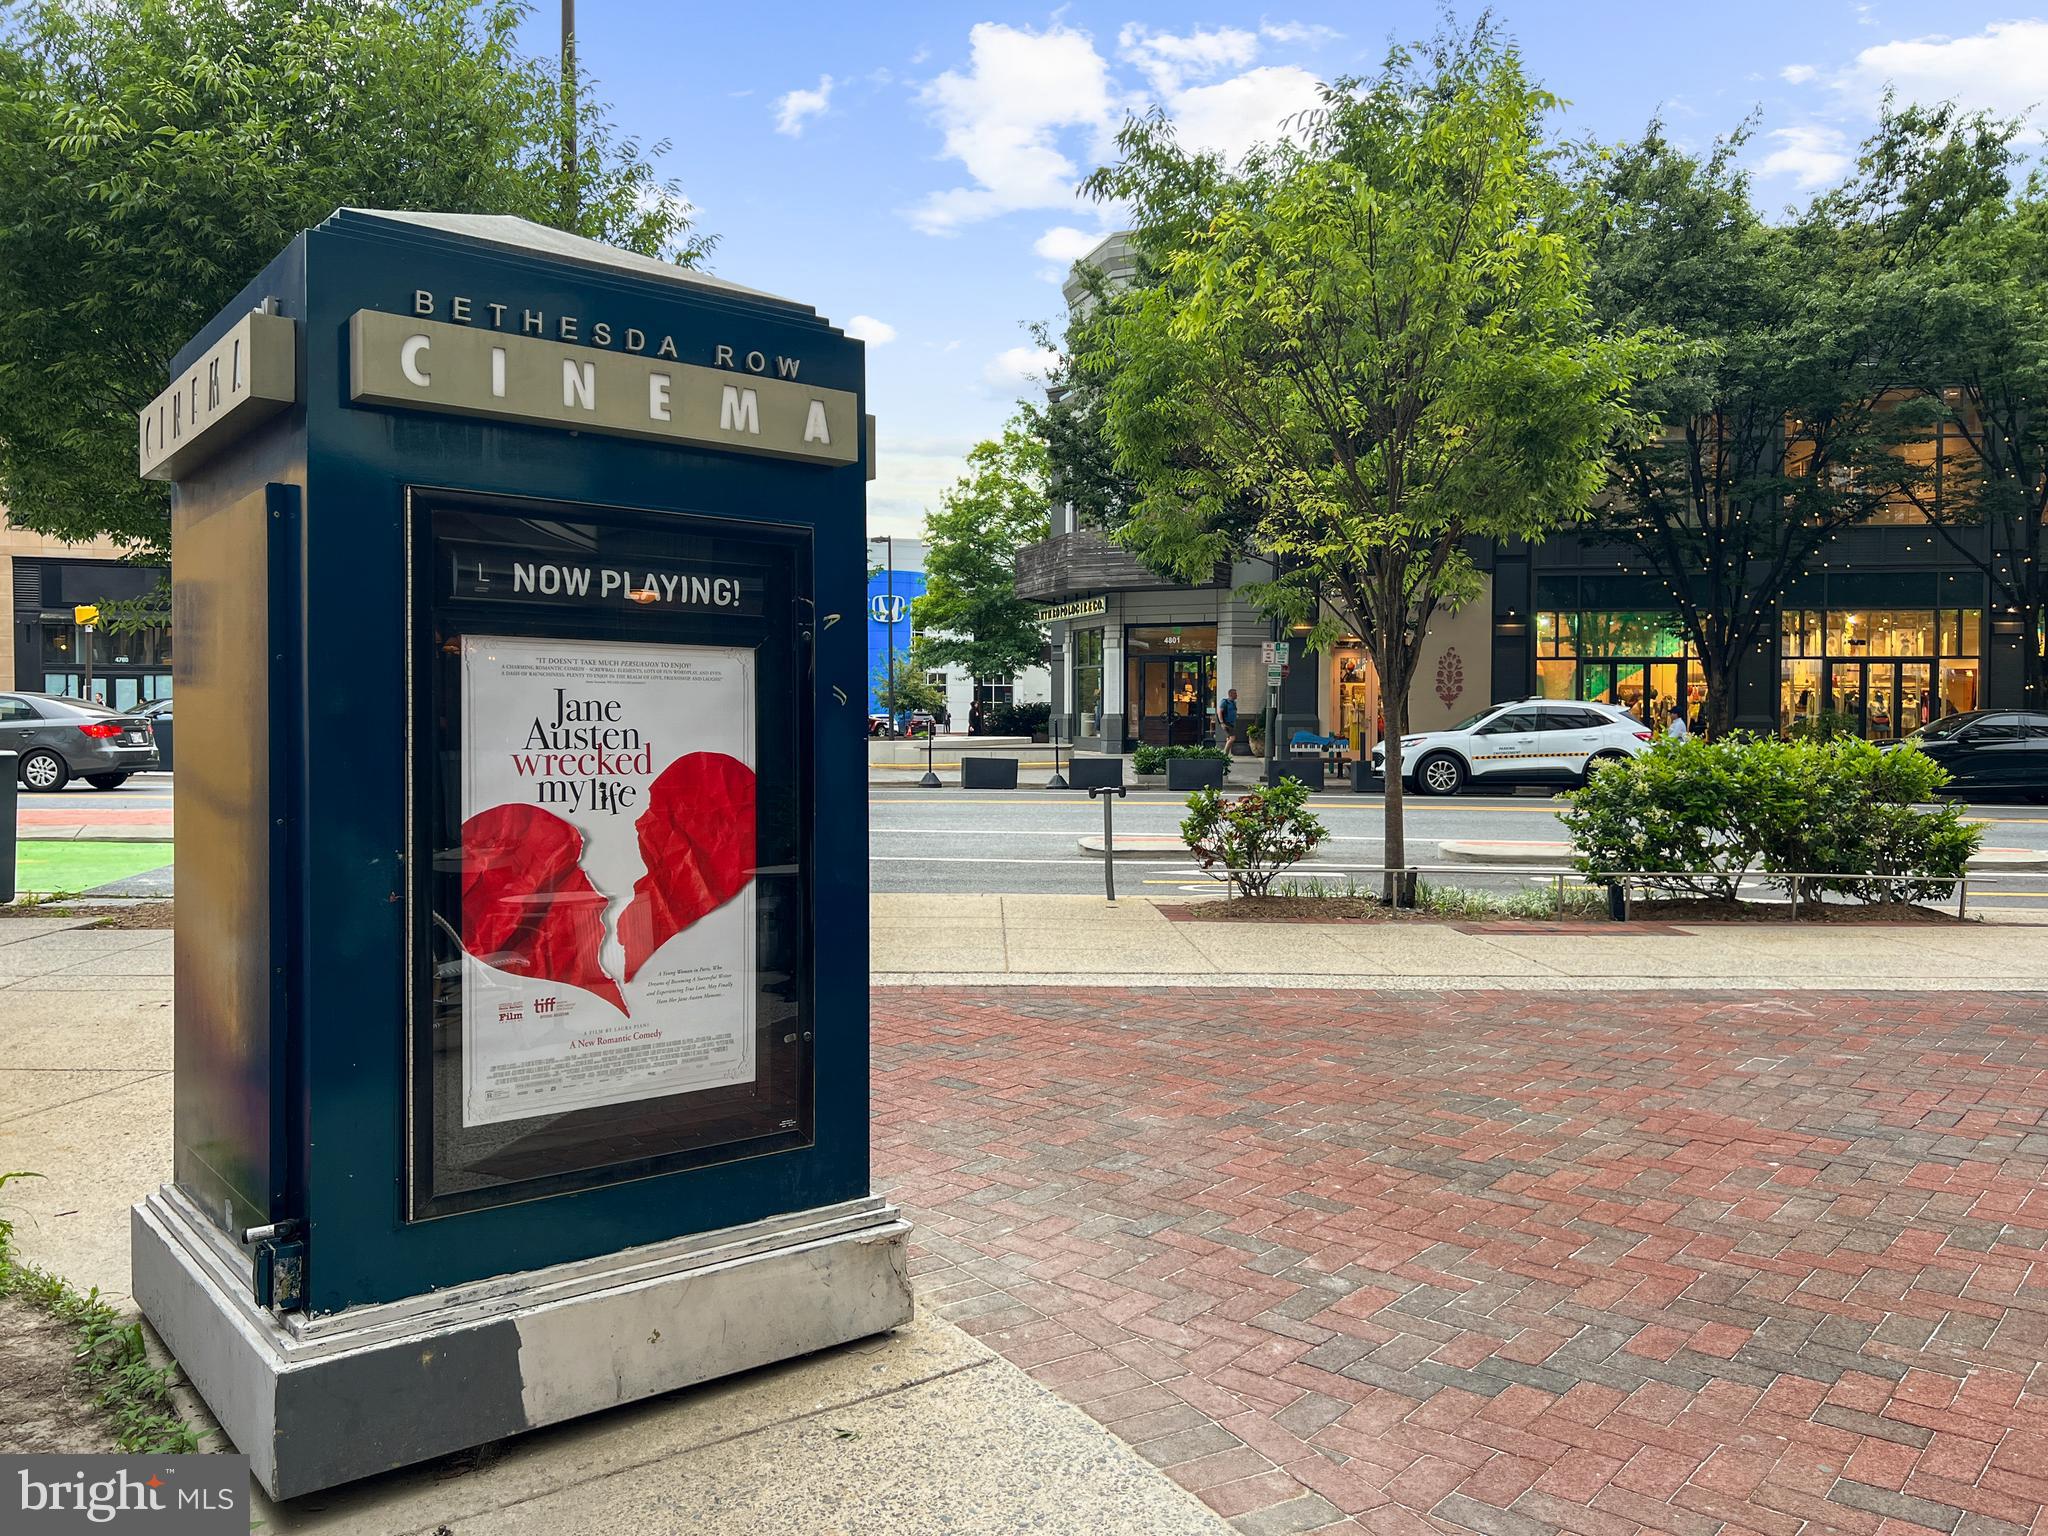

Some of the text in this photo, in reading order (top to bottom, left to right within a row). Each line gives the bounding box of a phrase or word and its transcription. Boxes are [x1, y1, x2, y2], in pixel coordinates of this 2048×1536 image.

[414, 289, 800, 379] BETHESDA ROW
[400, 334, 832, 445] CINEMA
[513, 562, 591, 597] NOW
[601, 569, 740, 607] PLAYING!
[1164, 636, 1181, 644] 4801
[580, 658, 597, 666] TAKE
[598, 659, 619, 667] MUCH
[620, 660, 659, 668] PERSUASION
[551, 688, 622, 730] Jane
[521, 716, 641, 750] Austen
[510, 742, 653, 777] wrecked
[536, 778, 637, 816] my life
[498, 1013, 523, 1022] Film
[534, 997, 556, 1013] tiff
[569, 1028, 663, 1049] A New Romantic Comedy
